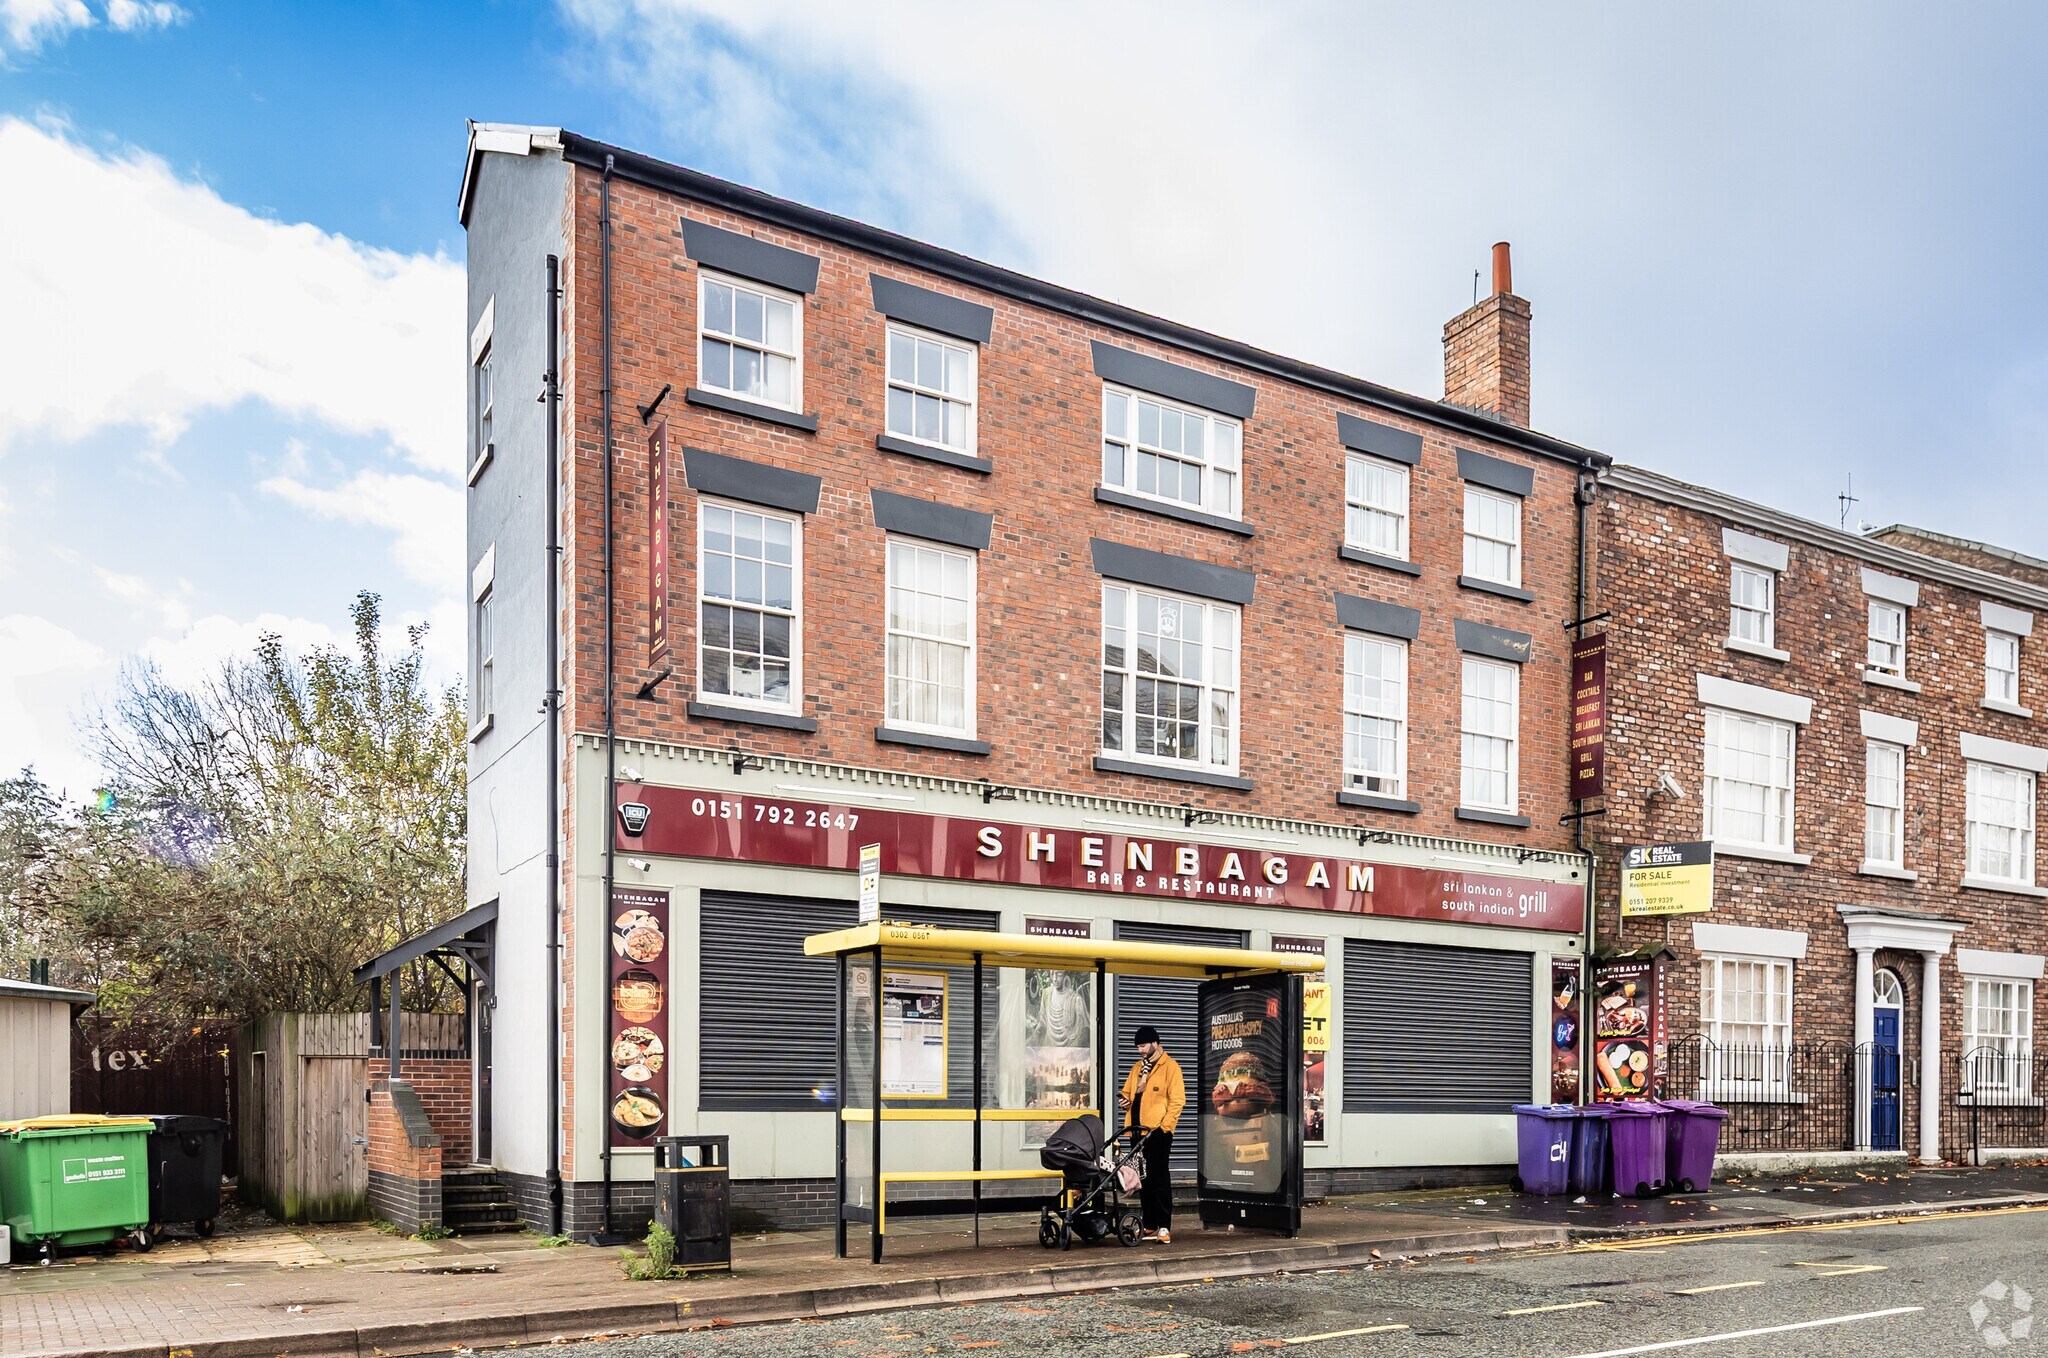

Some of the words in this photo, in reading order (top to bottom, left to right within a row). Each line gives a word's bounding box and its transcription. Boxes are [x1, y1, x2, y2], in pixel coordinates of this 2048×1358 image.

[653, 440, 662, 634] SHENBAGAM
[1584, 671, 1593, 682] BAR
[1576, 685, 1600, 699] COCKTAILS
[1576, 701, 1600, 716] BREAKFAST
[1575, 722, 1583, 732] SRI
[1583, 718, 1600, 731] LANKAN
[1572, 738, 1586, 749] SOUTH
[1586, 733, 1603, 746] INDIAN
[1580, 751, 1592, 763] GRILL
[1579, 767, 1595, 779] PIZZAS
[628, 808, 643, 817] ICU
[691, 798, 743, 820] 0151
[754, 804, 795, 825] 792
[804, 809, 859, 831] 2647
[1629, 847, 1652, 865] SK
[1652, 846, 1675, 855] REAL
[977, 826, 1375, 893] SHENBAGAM
[1652, 853, 1682, 863] ESTATE
[1629, 872, 1647, 881] FOR
[1649, 870, 1672, 880] SALE
[1087, 870, 1123, 886] BAR
[1135, 875, 1146, 888] &
[1158, 876, 1274, 899] RESTAURANT
[1443, 882, 1459, 893] sri
[1463, 882, 1502, 897] lankan
[1506, 887, 1514, 898] &
[612, 893, 666, 903] SHENBAGAM
[1441, 900, 1475, 912] south
[1480, 901, 1515, 916] indian
[1518, 890, 1547, 918] grill
[1629, 898, 1644, 906] 0151
[1629, 903, 1684, 913] skrealestate.co.uk
[1030, 926, 1087, 936] SHENBAGAM
[1275, 943, 1322, 952] SHENBAGAM
[1304, 989, 1324, 999] ANT
[1303, 1016, 1327, 1031] ET
[1211, 1039, 1223, 1051] HOT
[1222, 1037, 1243, 1050] GOODS
[91, 1046, 151, 1072] tex
